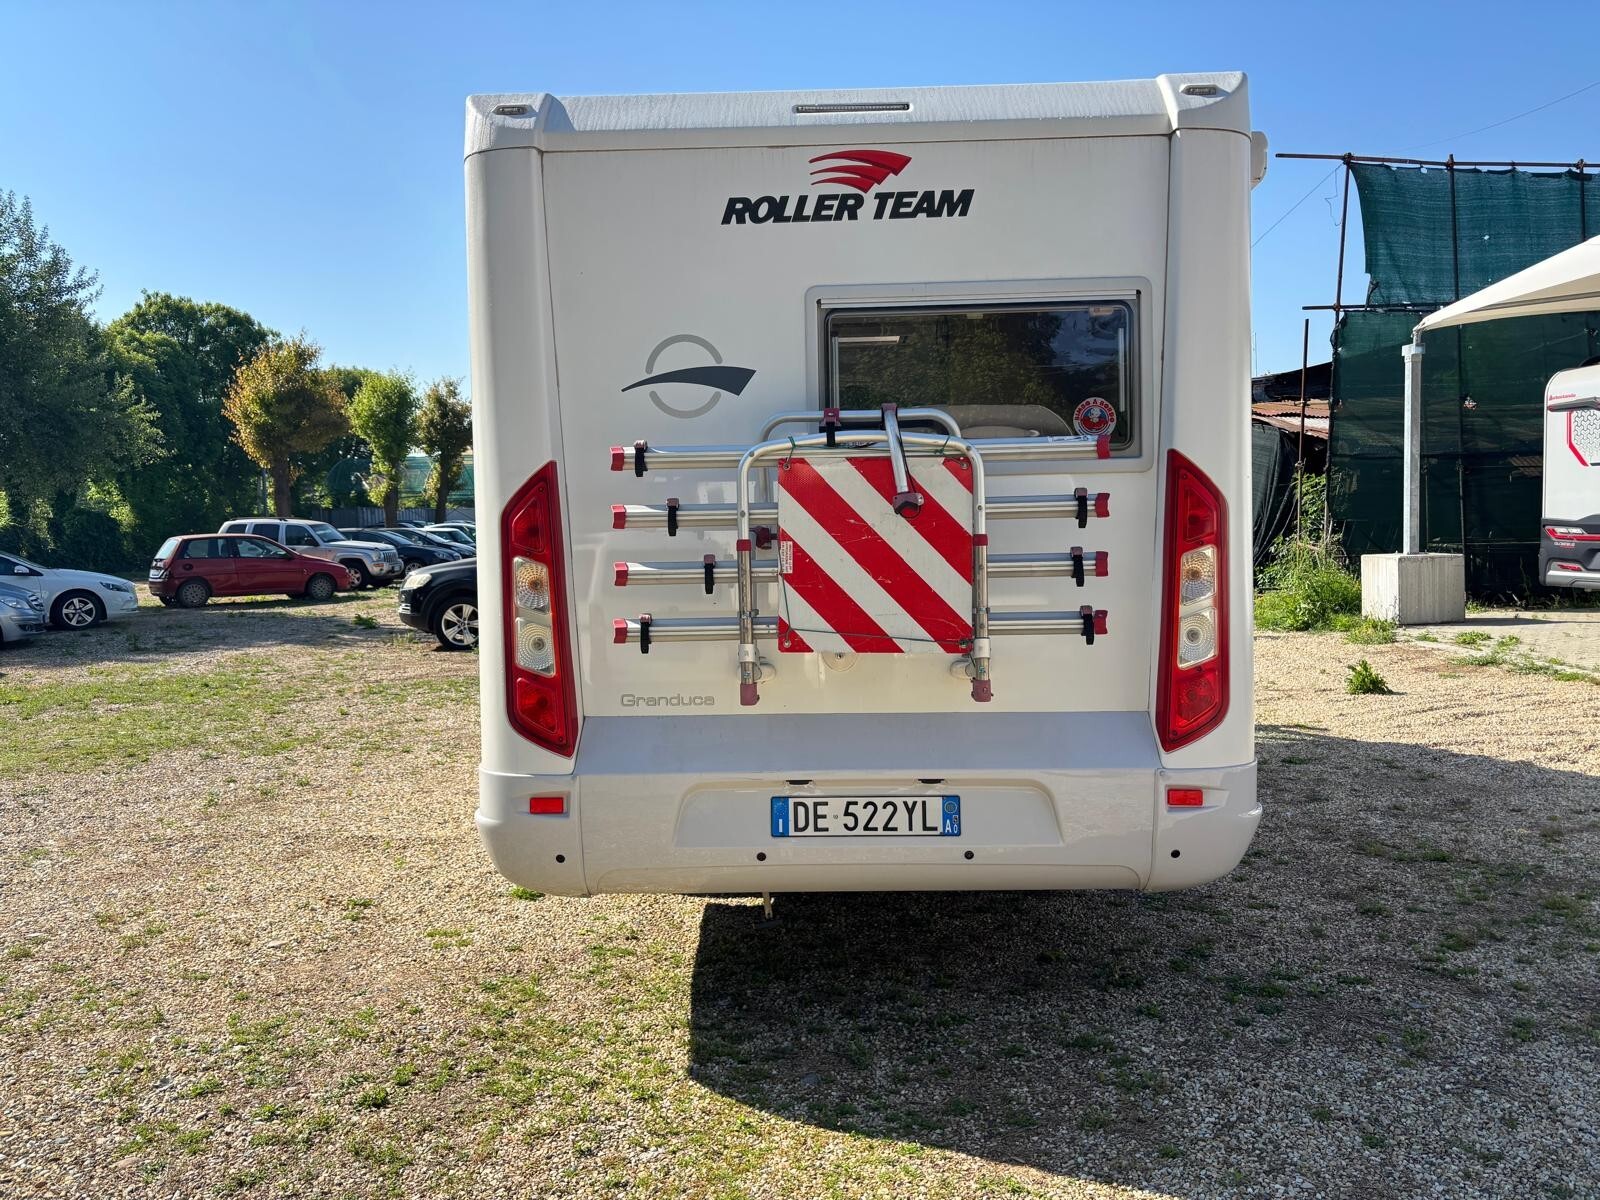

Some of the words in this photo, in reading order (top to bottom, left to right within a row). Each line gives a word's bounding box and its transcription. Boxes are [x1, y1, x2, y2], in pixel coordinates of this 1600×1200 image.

[721, 193, 864, 225] ROLLER
[873, 189, 975, 220] TEAM
[620, 693, 715, 707] Granduca
[793, 801, 829, 833] DE
[843, 800, 939, 832] 522YL
